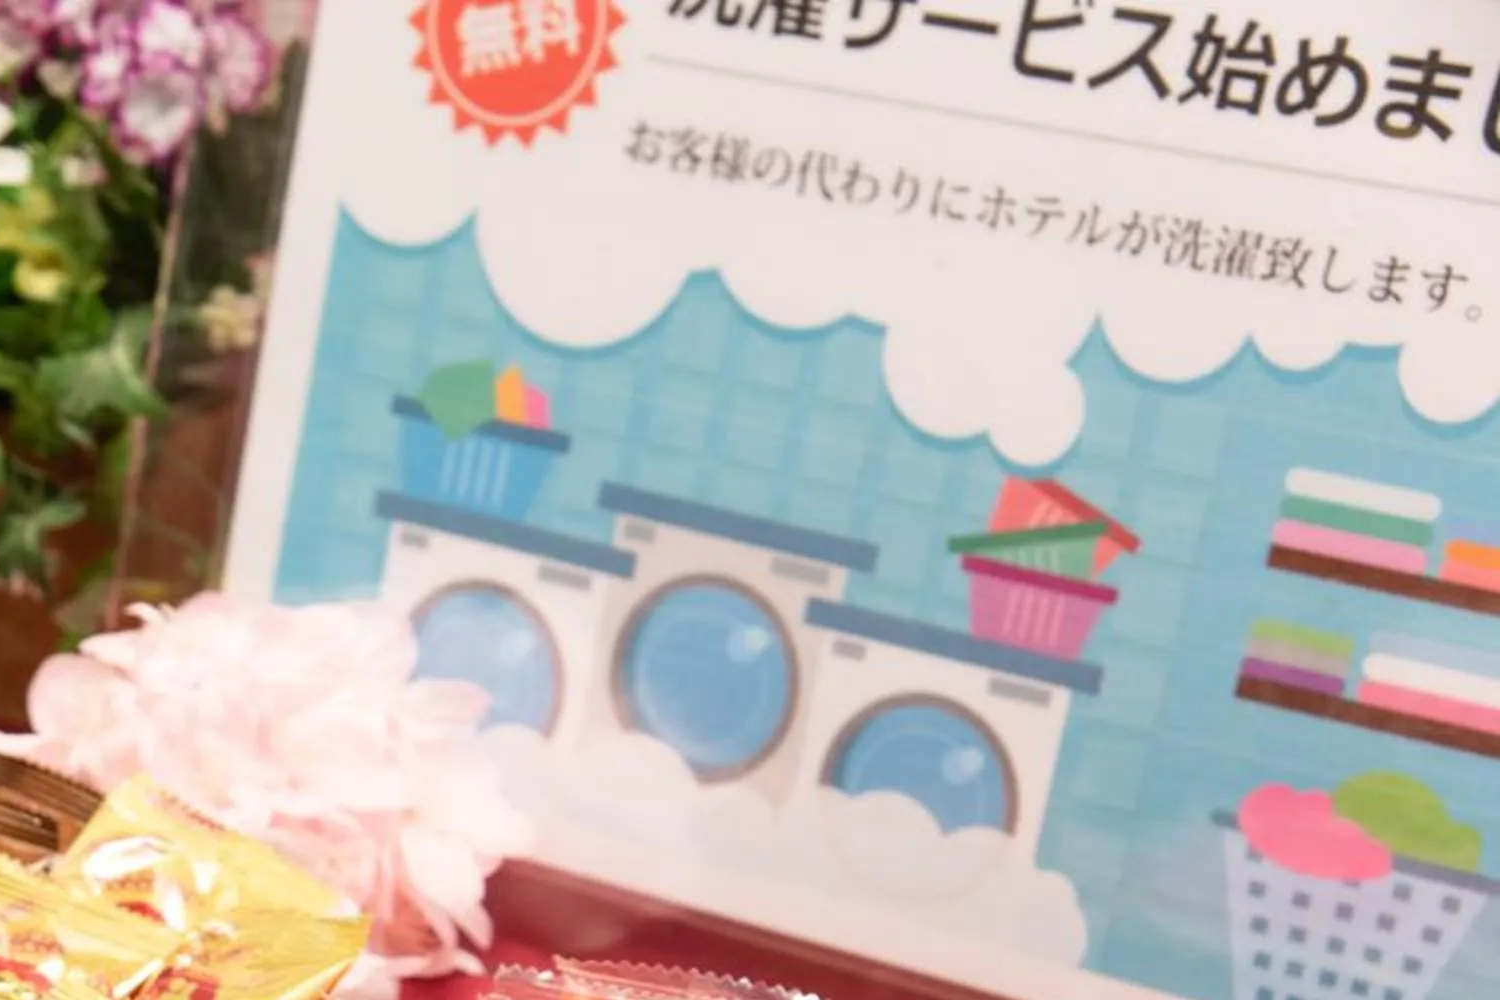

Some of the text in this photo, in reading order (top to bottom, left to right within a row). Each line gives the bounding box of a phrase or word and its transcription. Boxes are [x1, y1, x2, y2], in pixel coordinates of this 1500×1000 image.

[622, 118, 1484, 323] お客様の代わりにホテルが洗濯致します。
